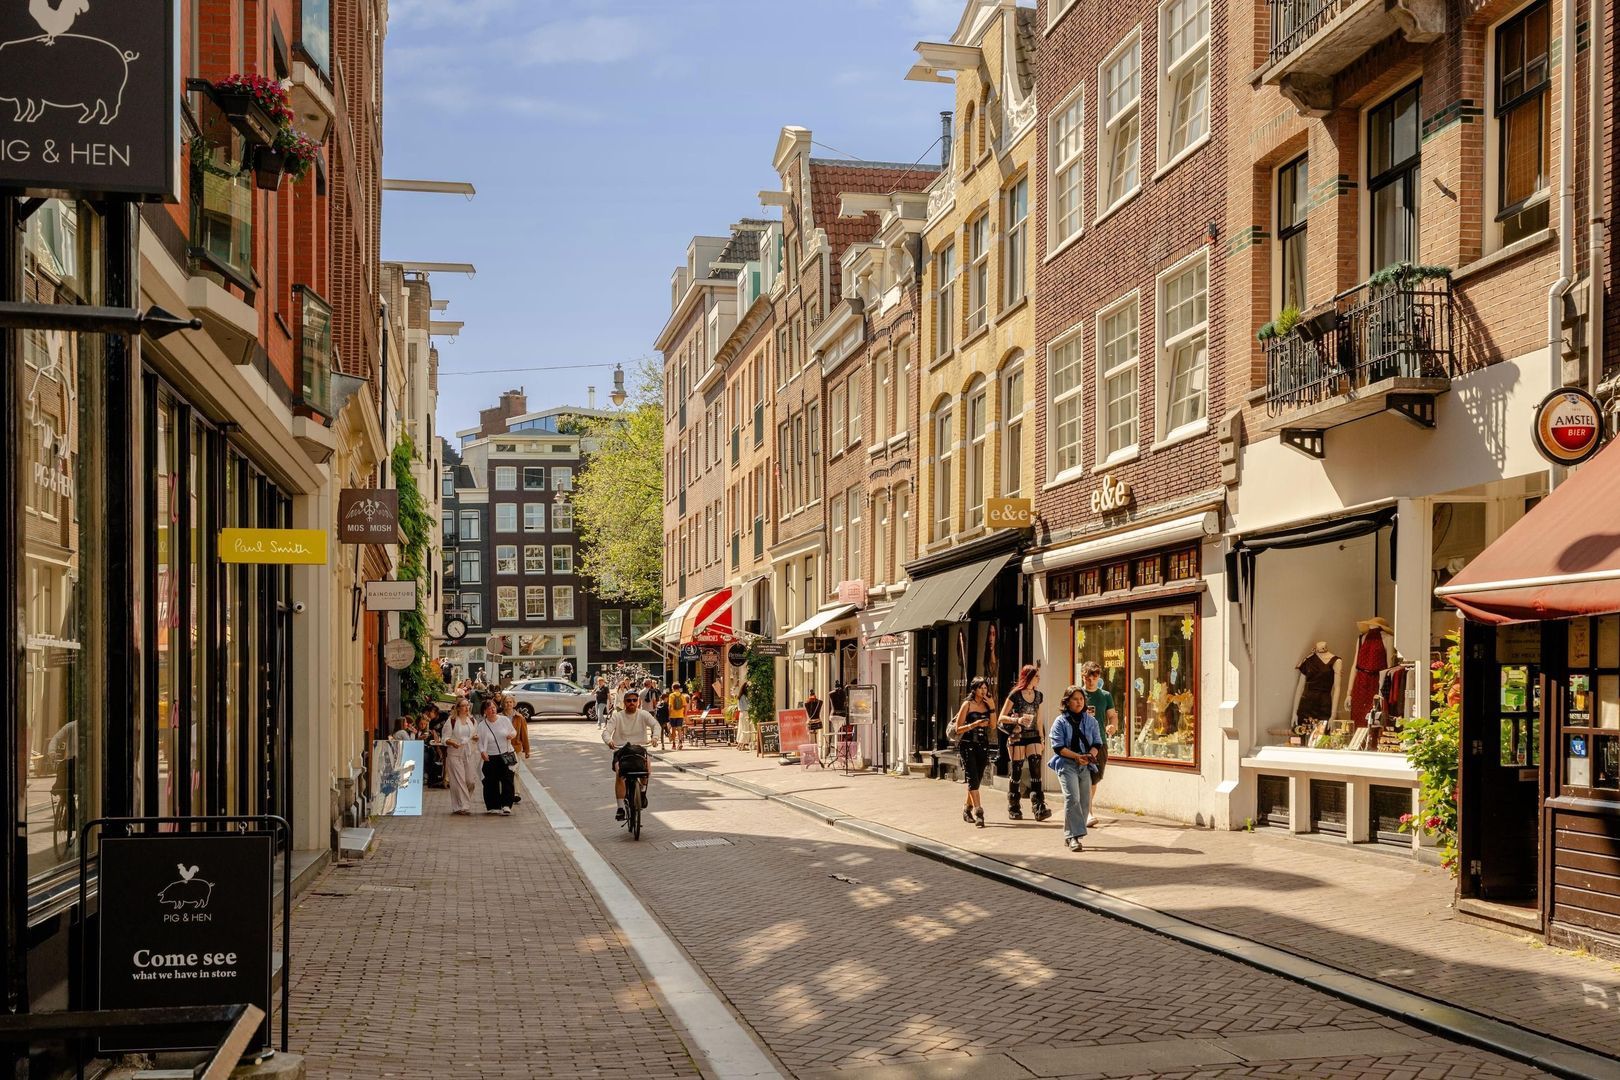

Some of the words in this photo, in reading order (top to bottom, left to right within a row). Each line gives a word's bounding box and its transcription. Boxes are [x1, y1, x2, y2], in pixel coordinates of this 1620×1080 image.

[1, 139, 31, 162] IG
[42, 139, 60, 163] &
[71, 142, 130, 166] HEN
[1555, 415, 1595, 426] AMSTEL
[1568, 428, 1586, 437] BIER
[1091, 474, 1128, 513] e&e
[990, 504, 1028, 521] e&e
[347, 524, 365, 532] MOS
[370, 524, 392, 532] MOSH
[234, 538, 265, 553] Paul
[270, 540, 311, 554] Smith
[761, 724, 778, 733] EXPO
[163, 913, 180, 922] PIG
[182, 913, 189, 922] &
[191, 913, 212, 922] HEN
[133, 949, 198, 968] Come
[203, 952, 237, 966] see
[132, 971, 157, 980] what
[174, 970, 198, 979] have
[199, 970, 210, 978] in
[211, 970, 237, 978] store
